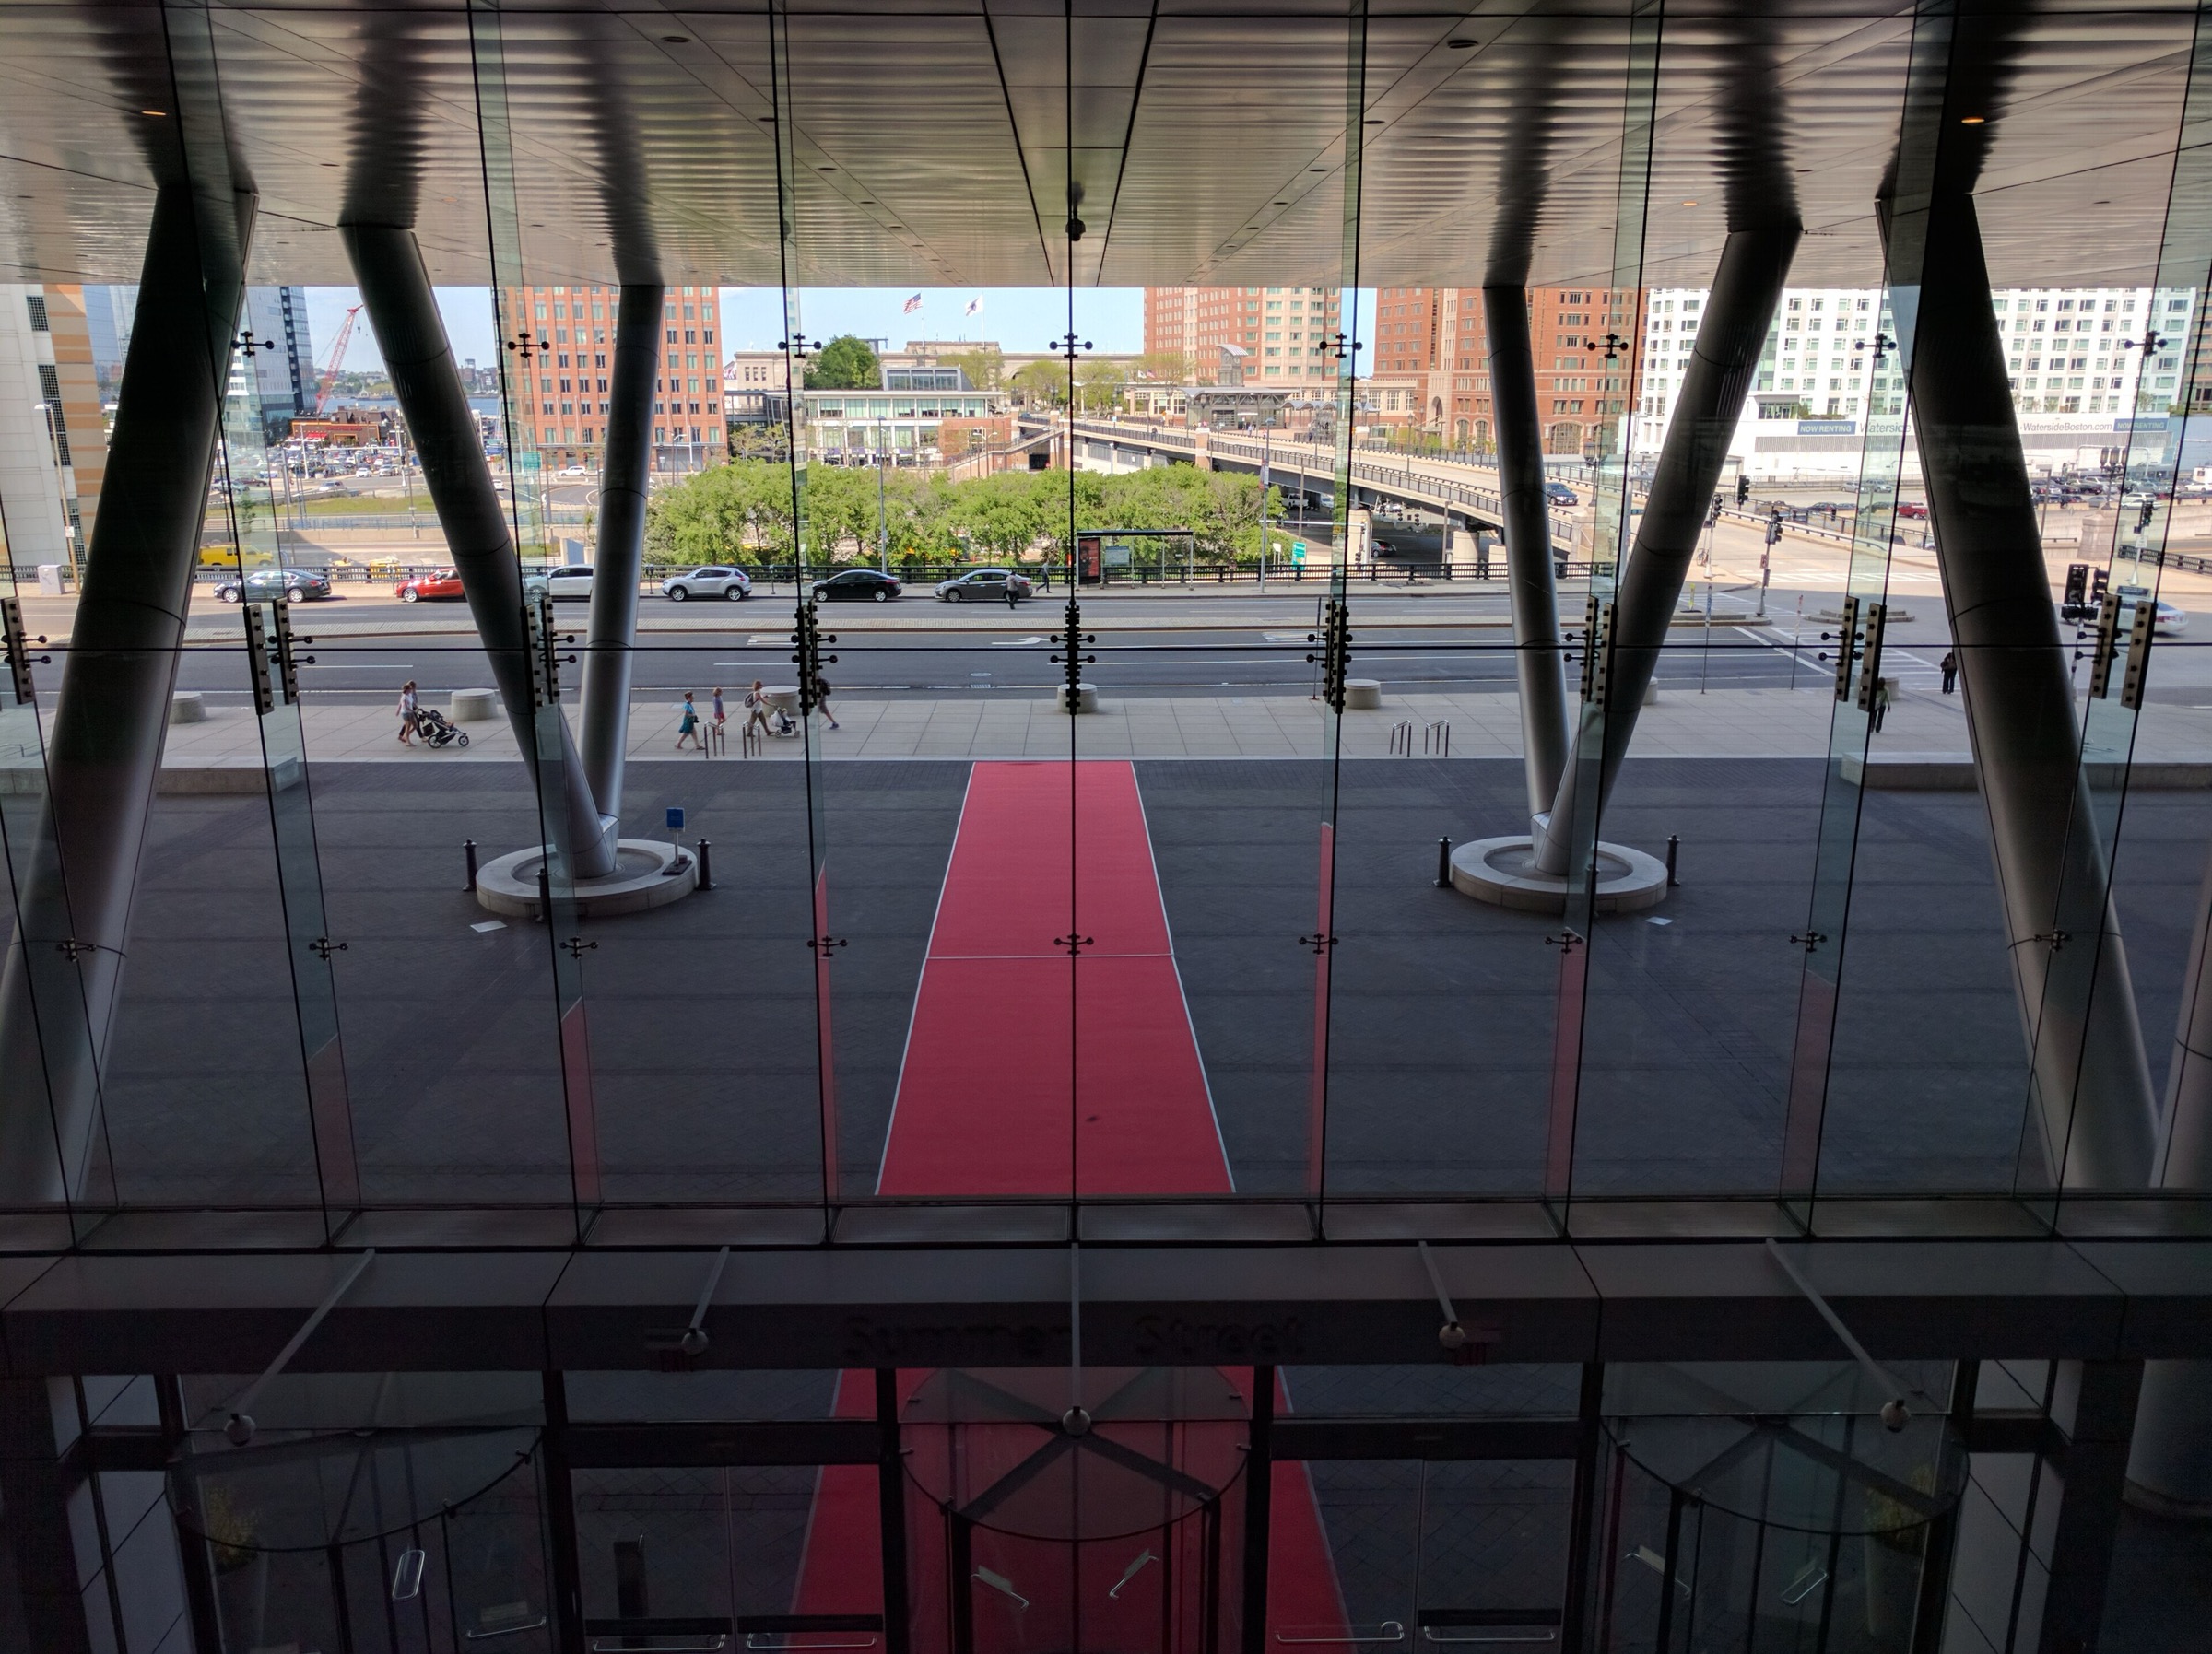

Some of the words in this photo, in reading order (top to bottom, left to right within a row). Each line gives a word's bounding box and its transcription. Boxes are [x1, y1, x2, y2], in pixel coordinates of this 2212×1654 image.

[1800, 425, 1818, 433] NOW
[1818, 425, 1852, 433] RENTING
[2023, 422, 2112, 432] WatersideBoston.com
[842, 1314, 1073, 1360] Summer
[1134, 1313, 1306, 1357] Street
